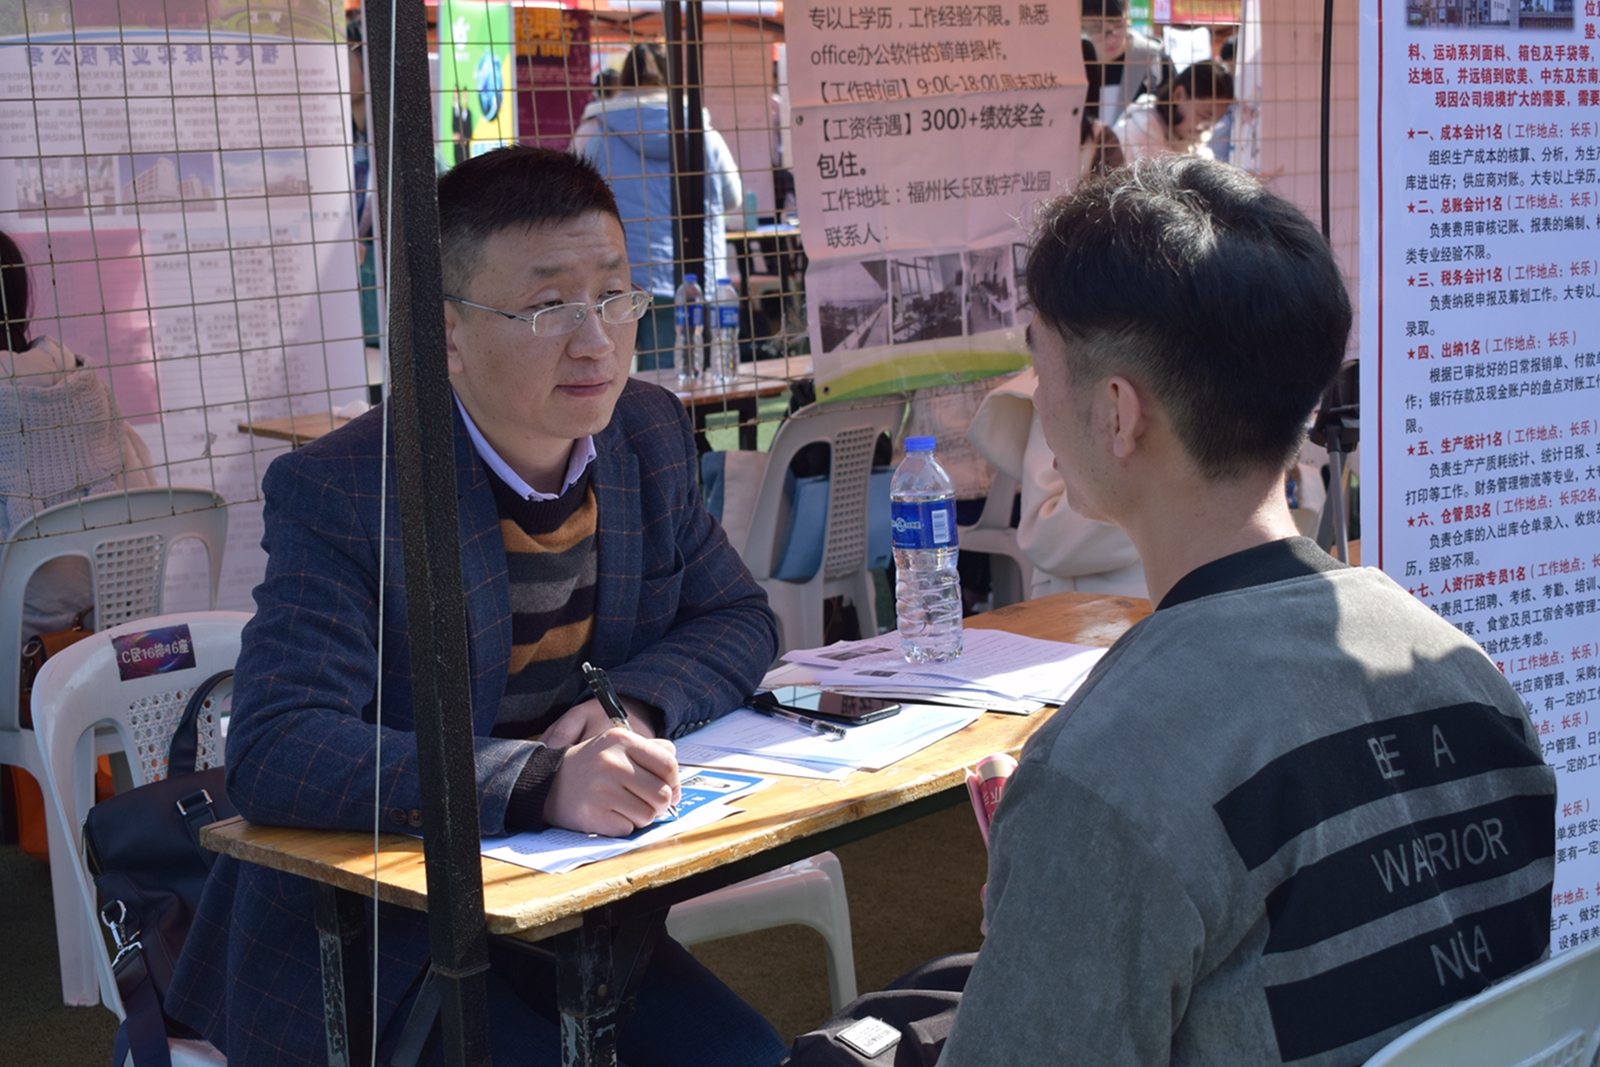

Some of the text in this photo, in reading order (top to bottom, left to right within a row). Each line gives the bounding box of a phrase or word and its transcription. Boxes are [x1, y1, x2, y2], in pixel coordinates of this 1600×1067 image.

[810, 39, 1007, 67] office办公软件的简单操作。
[1408, 43, 1595, 62] 料、运动系列面料、箱包及手袋等，
[817, 151, 867, 180] 包住。
[1405, 244, 1492, 265] 类专业经验不限。
[1405, 320, 1436, 337] 录取。
[1405, 418, 1424, 434] 限。
[1405, 551, 1481, 577] 历，经验不限。
[1367, 724, 1456, 780] BE A
[1541, 731, 1600, 757] 户管理、日
